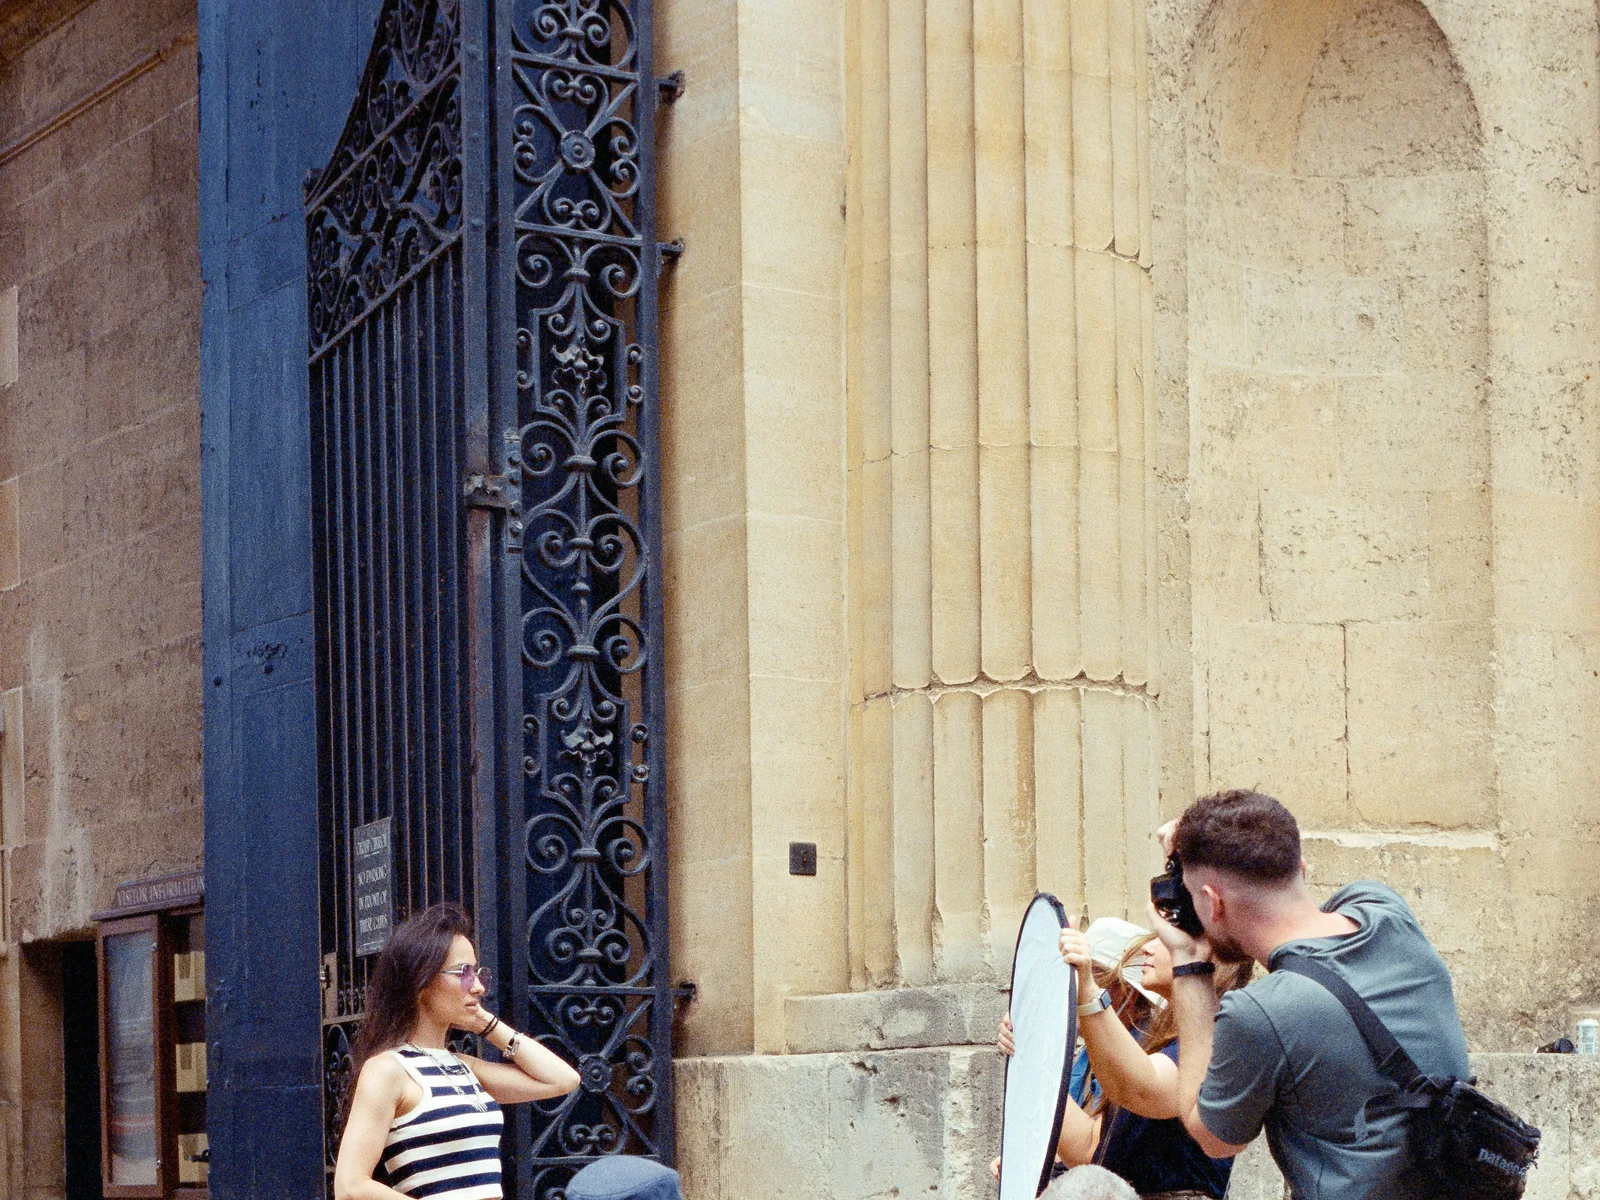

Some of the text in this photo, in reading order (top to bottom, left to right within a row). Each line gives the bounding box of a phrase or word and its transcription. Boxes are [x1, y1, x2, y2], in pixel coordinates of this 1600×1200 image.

[366, 864, 388, 882] PARKING
[117, 875, 205, 907] VISITOR INFORMATION
[1477, 1148, 1527, 1177] patago
